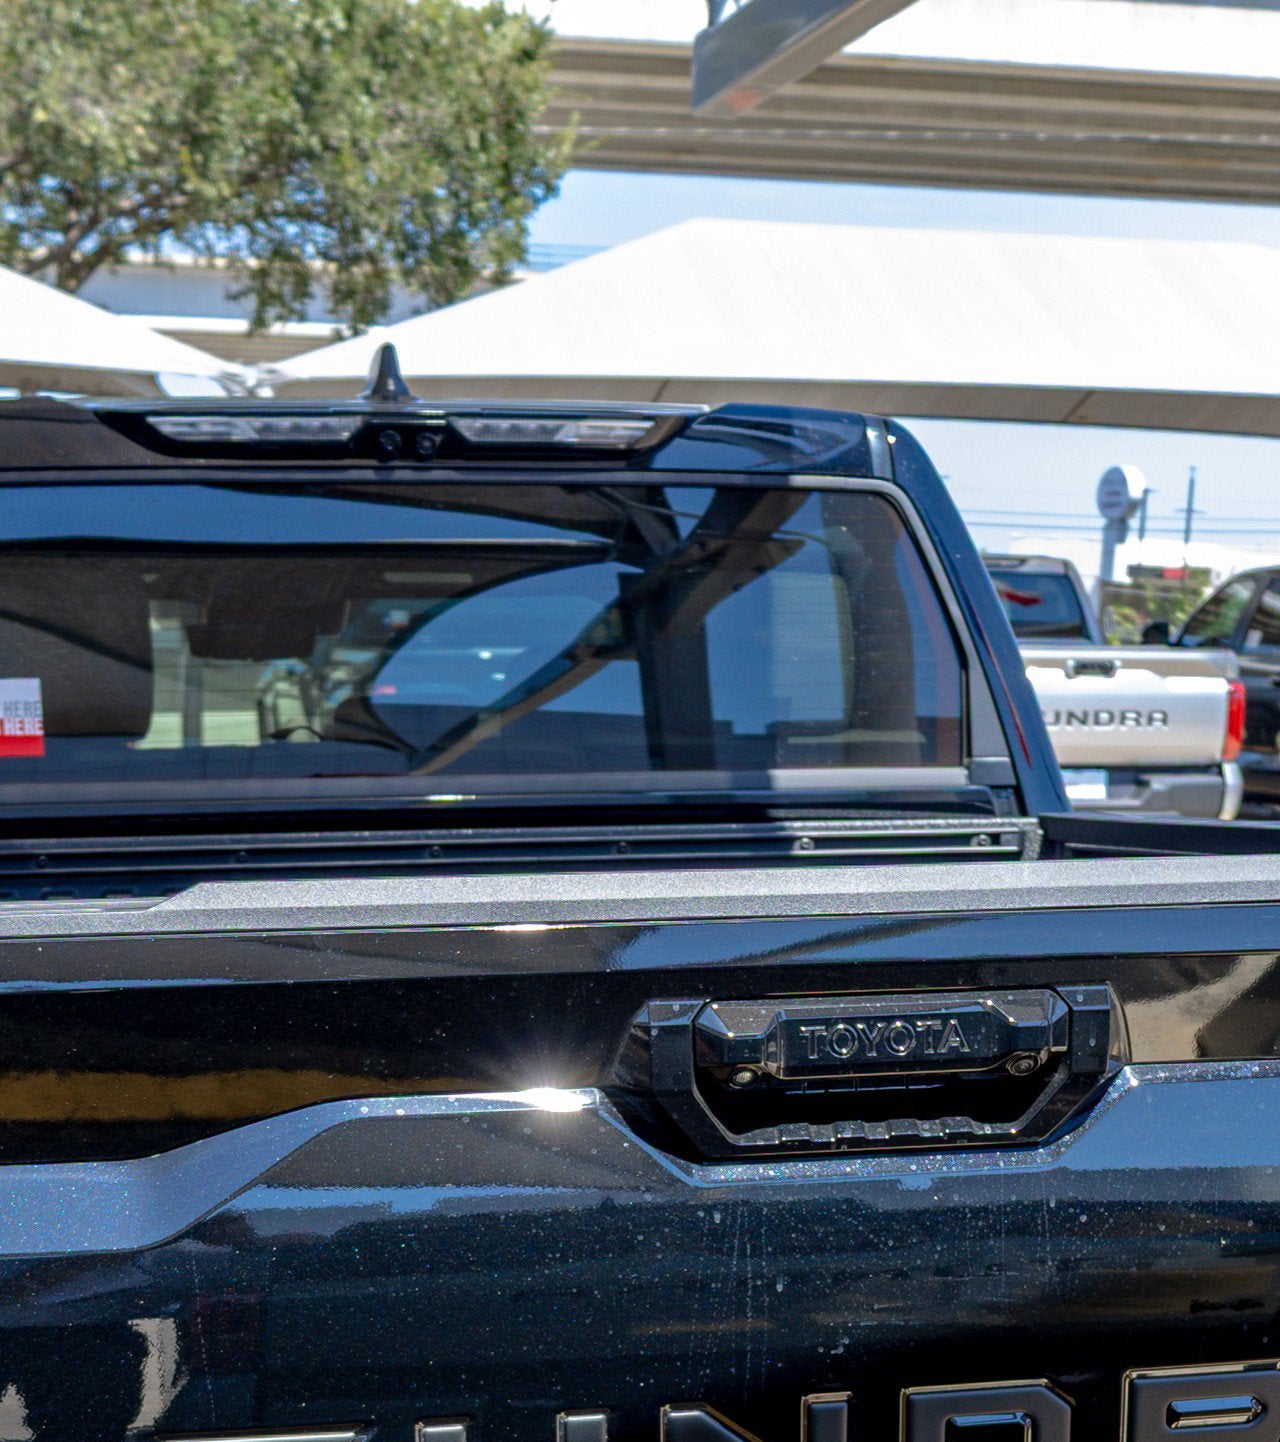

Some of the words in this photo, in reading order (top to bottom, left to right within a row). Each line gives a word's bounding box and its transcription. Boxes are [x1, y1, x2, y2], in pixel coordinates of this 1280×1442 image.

[3, 701, 42, 718] HERE
[1041, 709, 1170, 727] UNDRA
[3, 718, 44, 735] HERE
[799, 1019, 971, 1059] TOYOTA
